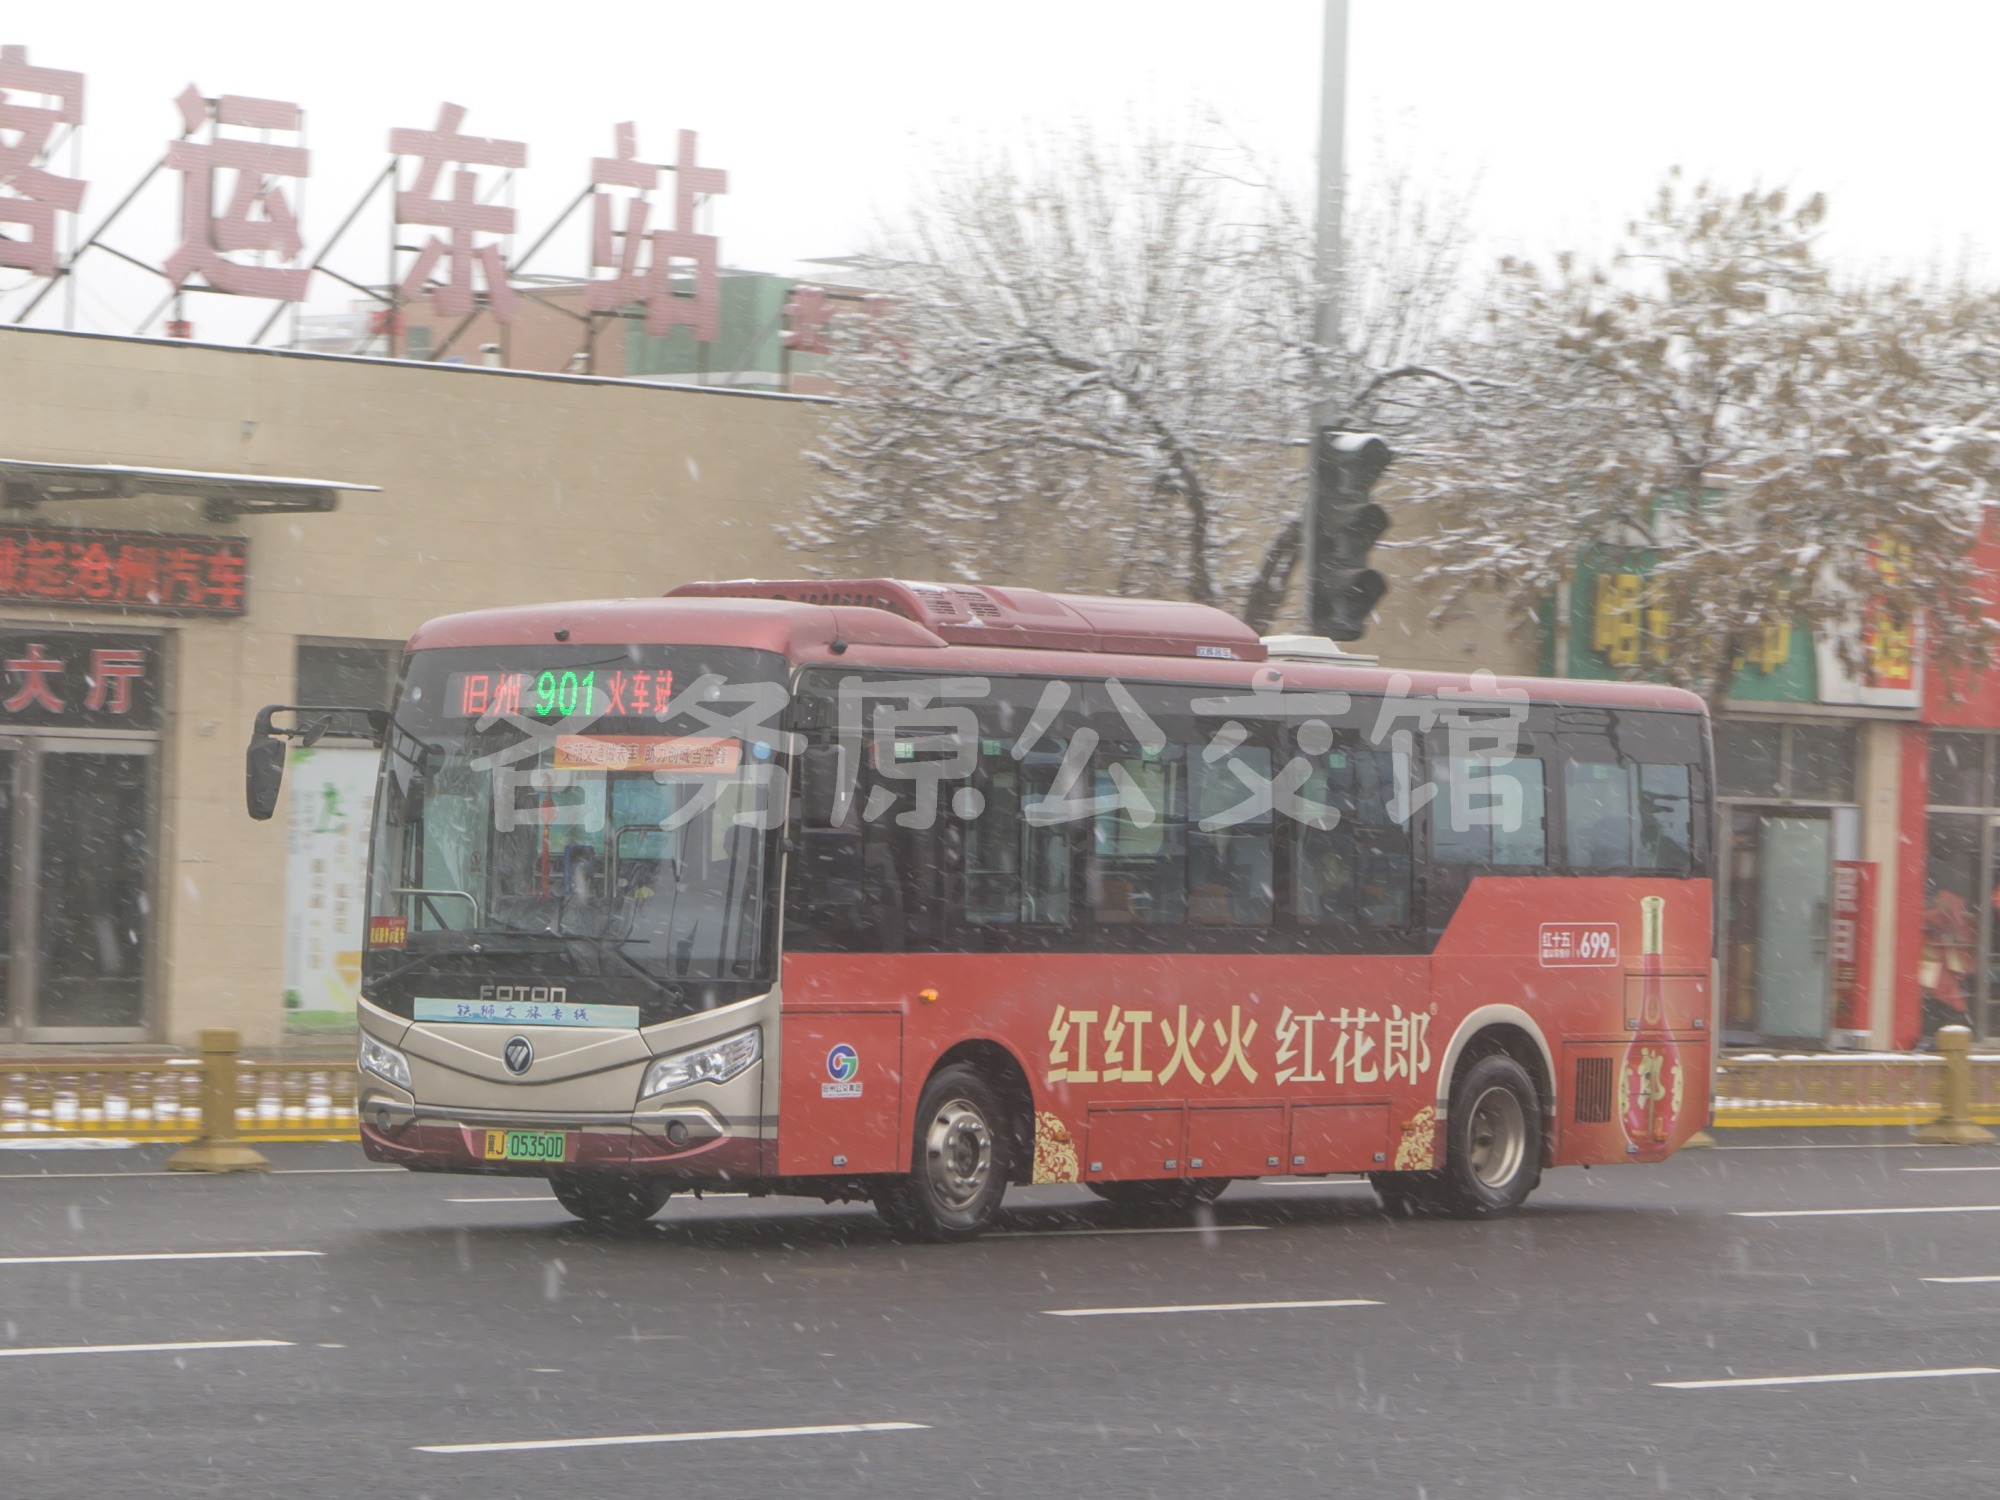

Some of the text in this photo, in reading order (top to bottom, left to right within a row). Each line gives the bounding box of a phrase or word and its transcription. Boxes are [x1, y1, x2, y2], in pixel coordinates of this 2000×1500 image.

[4, 643, 145, 714] 大厅
[462, 670, 674, 716] 旧州 901 火车站
[1542, 931, 1571, 948] 红十五
[480, 985, 567, 1003] FOTON
[457, 1003, 589, 1022] 铁狮文旅专线
[1047, 1004, 1432, 1087] 红红火火 红花郎
